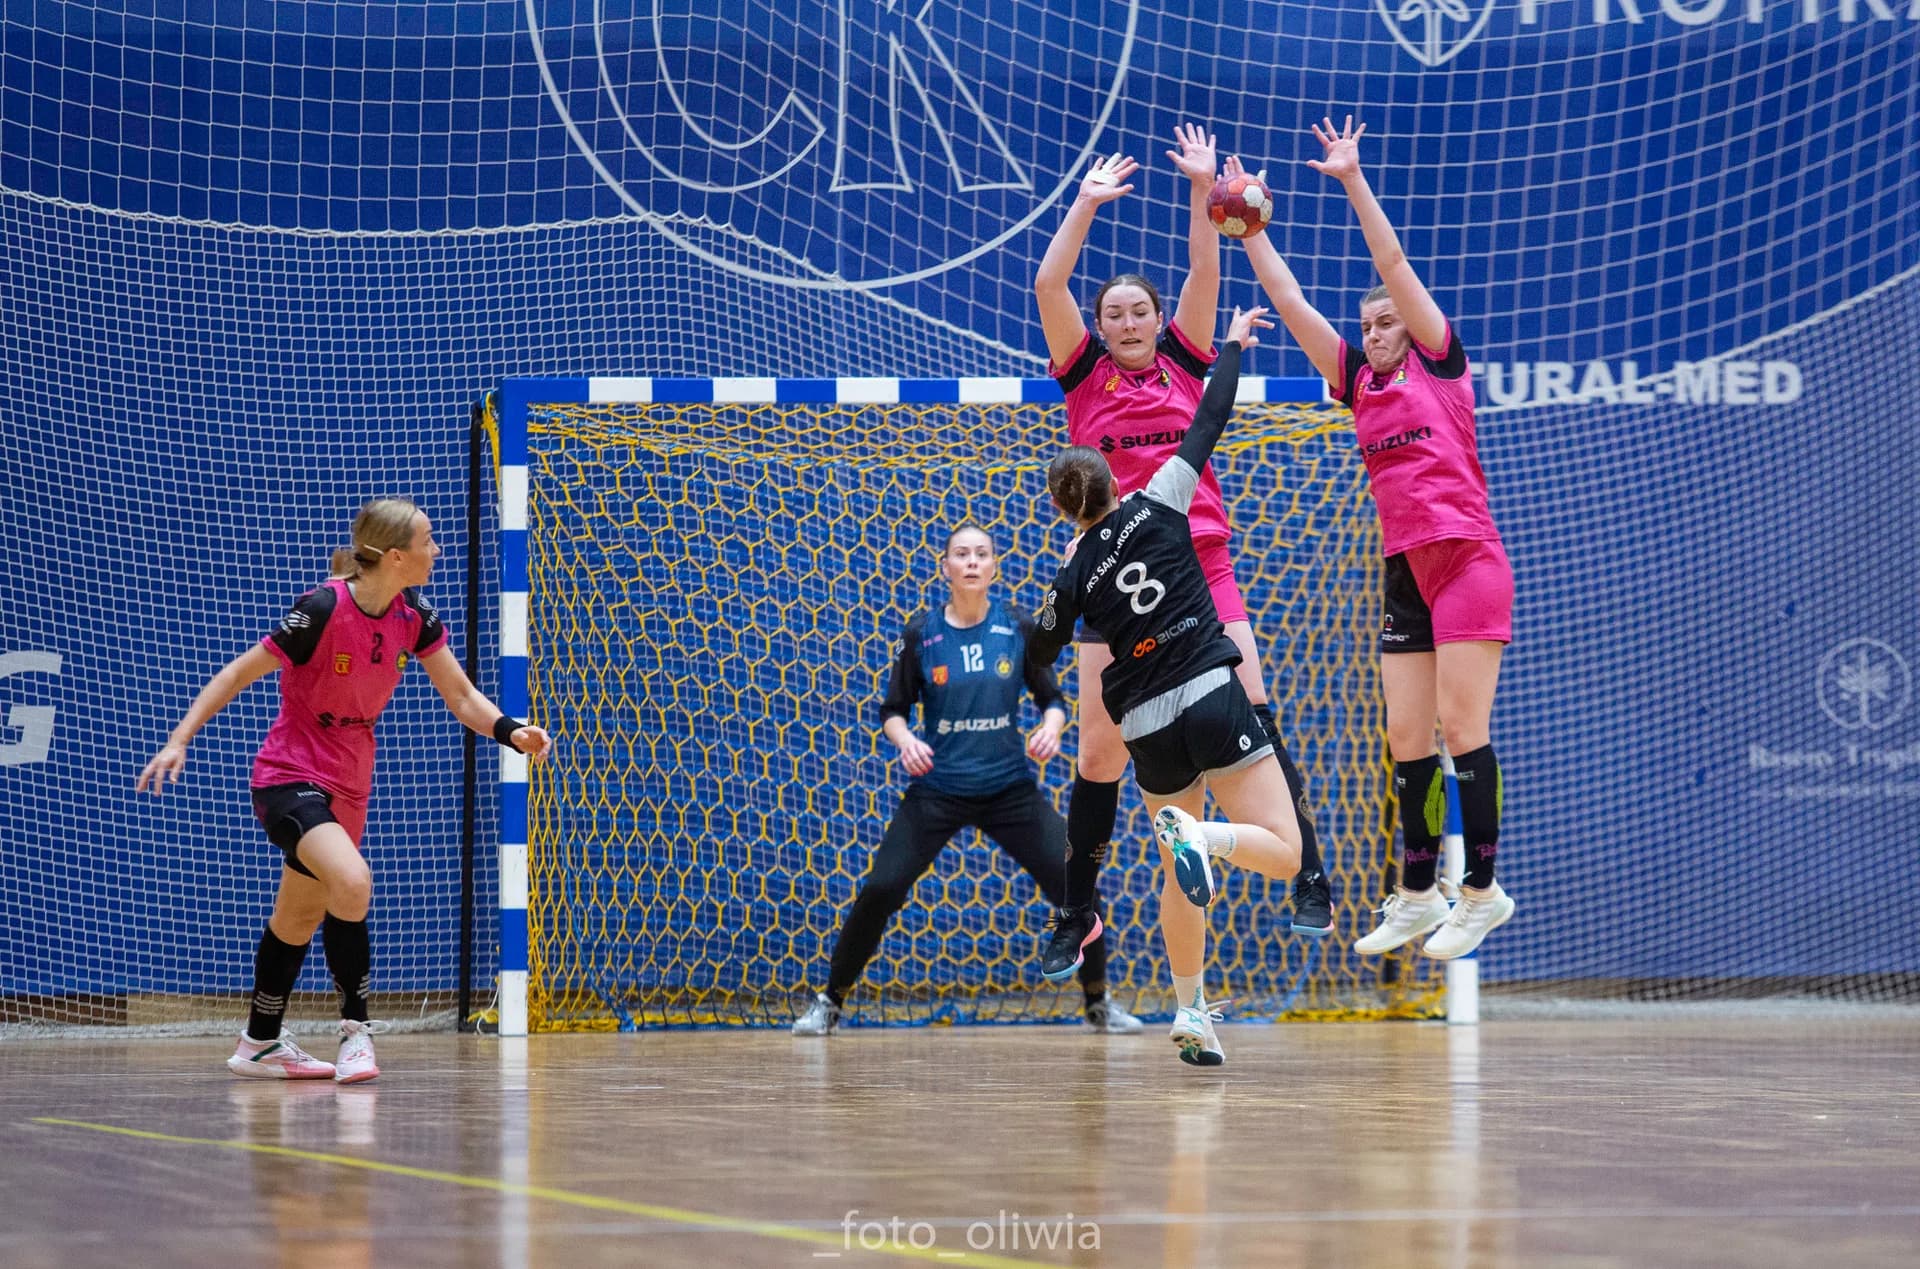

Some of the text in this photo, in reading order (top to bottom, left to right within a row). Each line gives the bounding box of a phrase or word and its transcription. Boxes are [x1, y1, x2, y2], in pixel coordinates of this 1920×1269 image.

[1366, 426, 1432, 456] SUZUKI
[1097, 554, 1117, 576] SAN
[1115, 561, 1167, 615] 8
[371, 632, 384, 664] 2
[960, 643, 985, 672] 12
